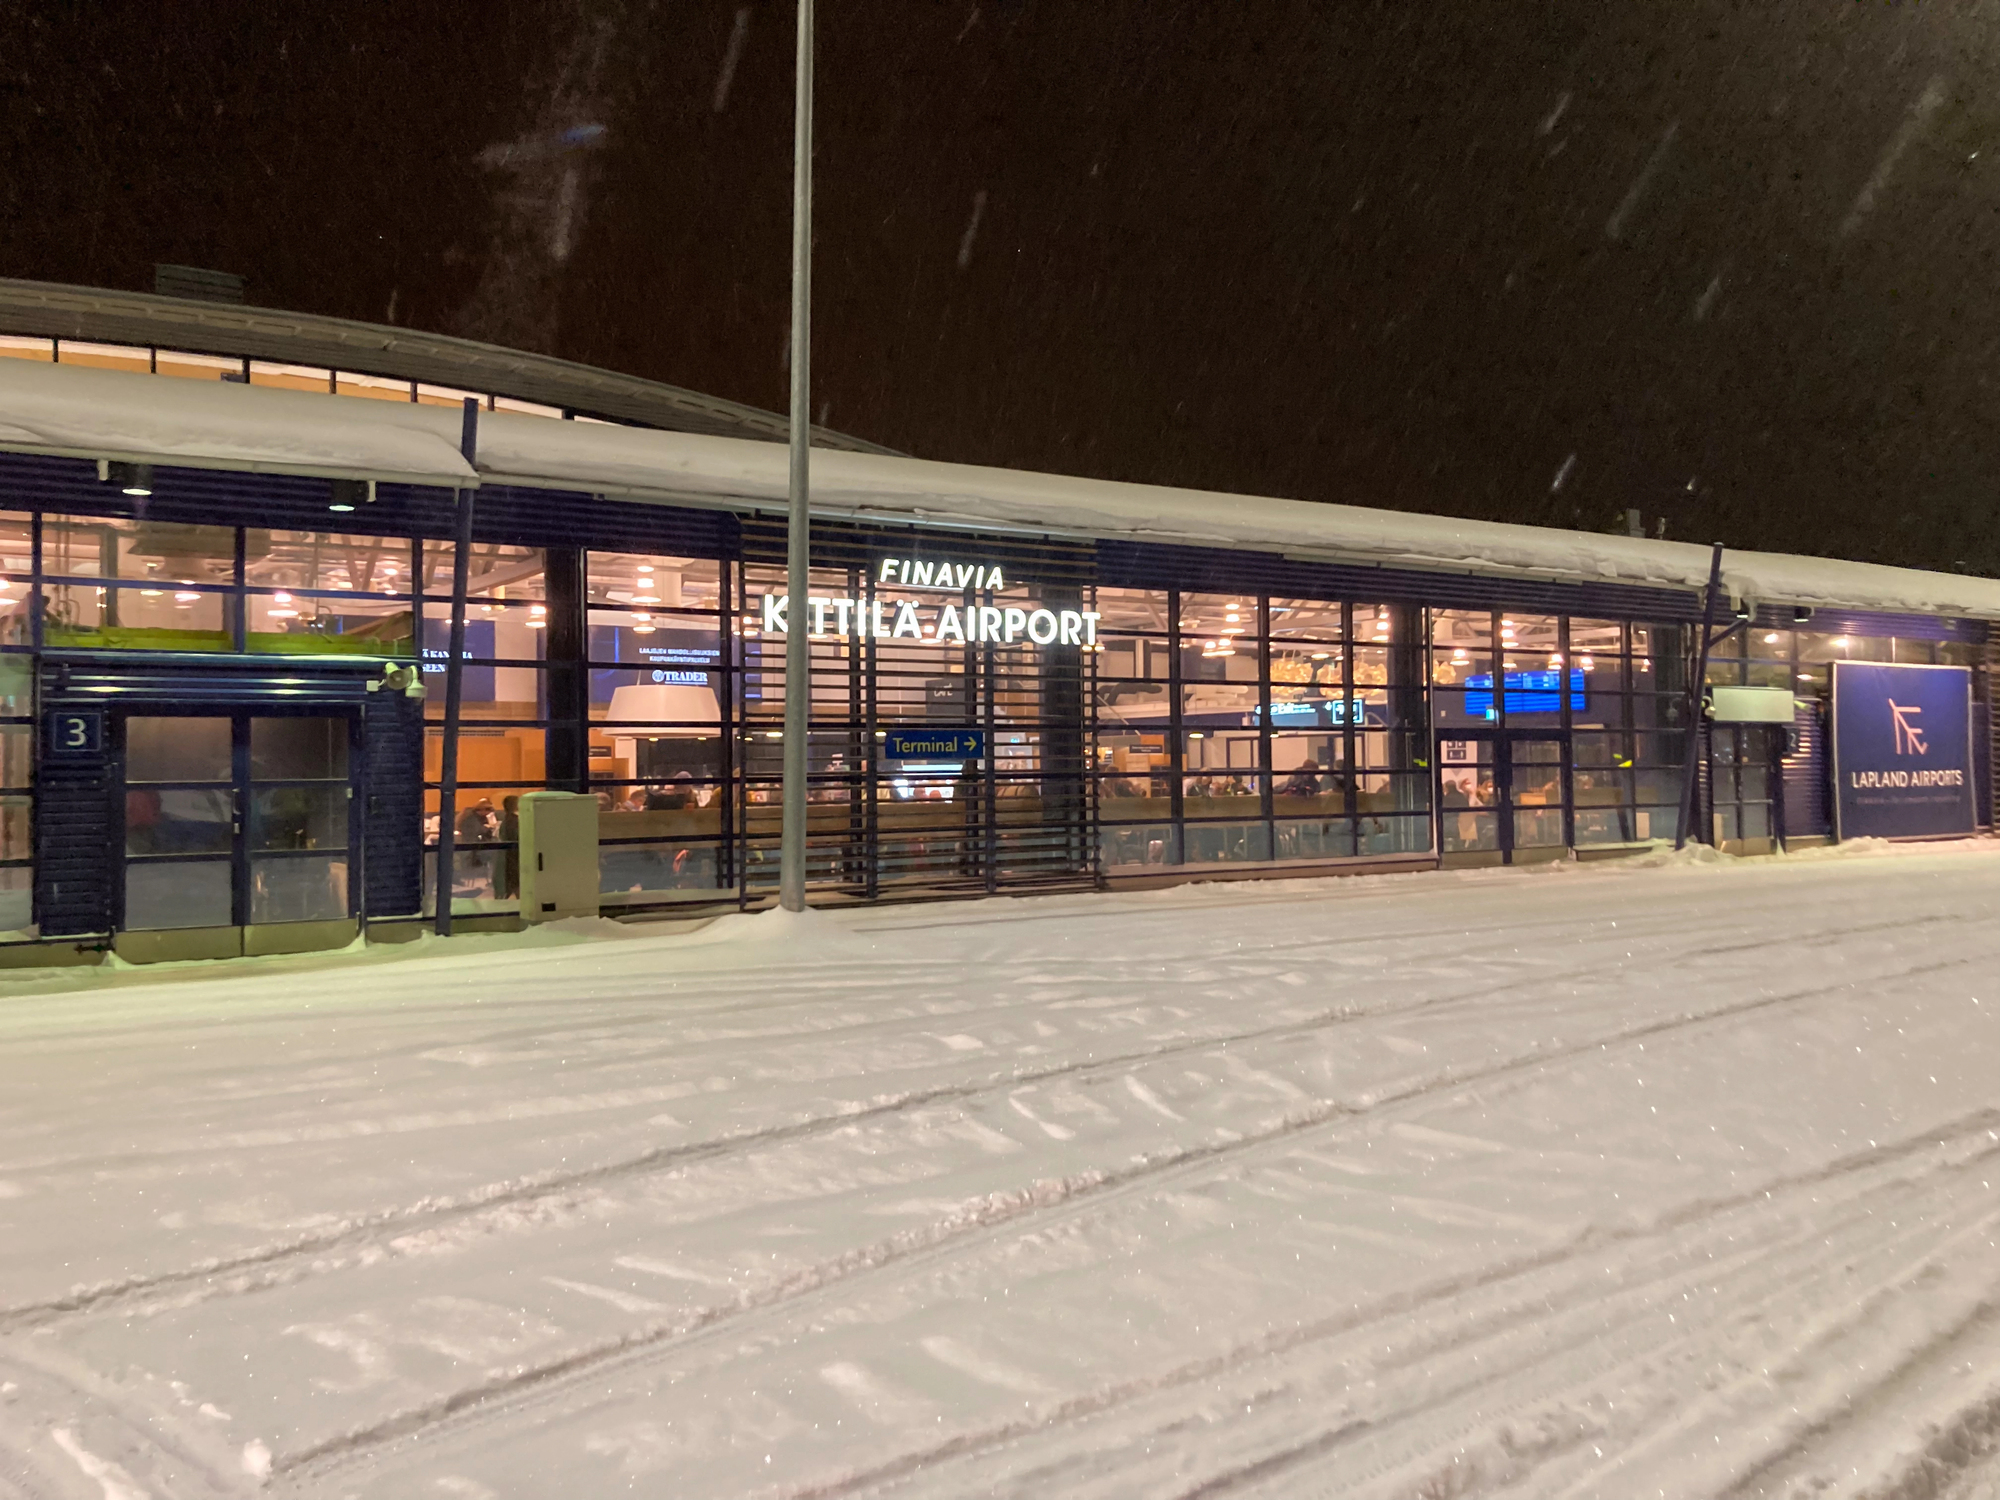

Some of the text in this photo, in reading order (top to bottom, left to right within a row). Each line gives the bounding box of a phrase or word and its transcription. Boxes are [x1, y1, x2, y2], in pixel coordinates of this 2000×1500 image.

[879, 558, 1004, 590] FINAVIA
[763, 593, 1101, 645] KTTILÄ AIRPORT
[664, 671, 708, 681] TRADER
[66, 718, 86, 746] 3
[1790, 733, 1796, 747] 2
[892, 736, 958, 753] Terminal
[1851, 769, 1964, 788] LAPLAND AIRPORTS
